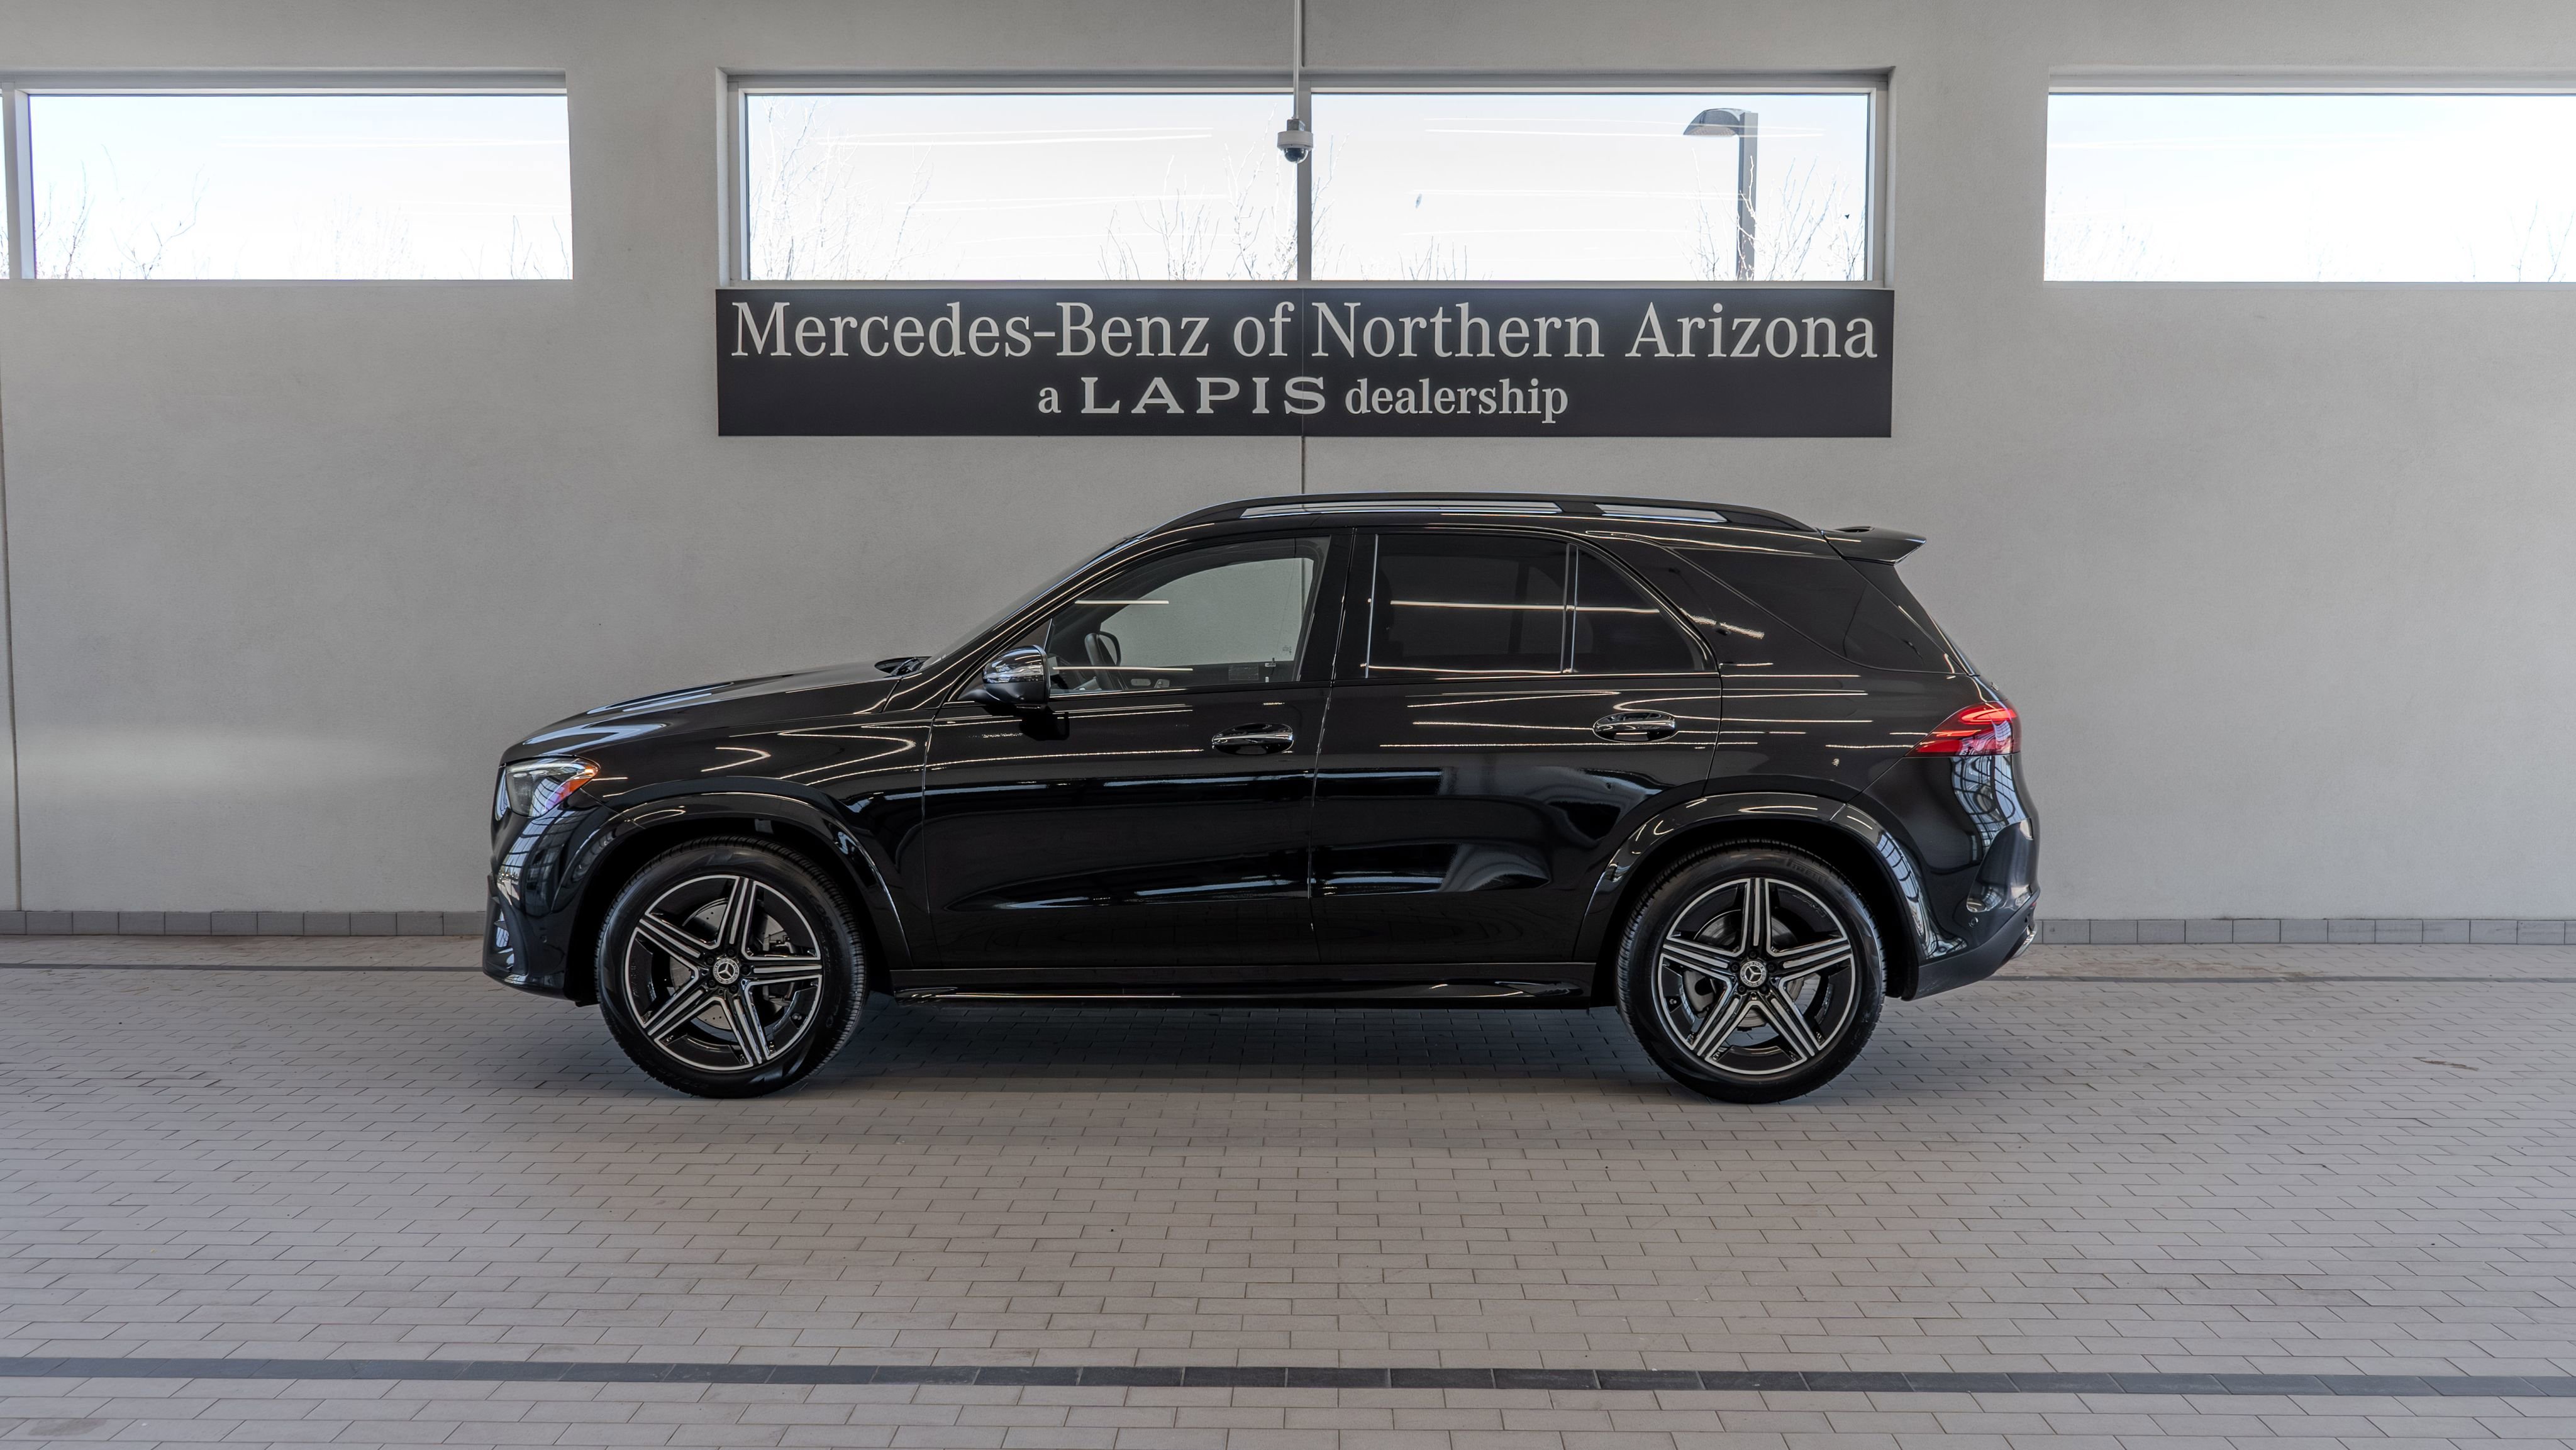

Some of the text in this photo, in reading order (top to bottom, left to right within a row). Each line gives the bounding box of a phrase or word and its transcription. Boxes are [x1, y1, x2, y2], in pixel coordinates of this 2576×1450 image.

[731, 301, 1878, 359] Mercedes-Benz of Northern Arizona
[1038, 376, 1568, 424] a LAPIS dealership
